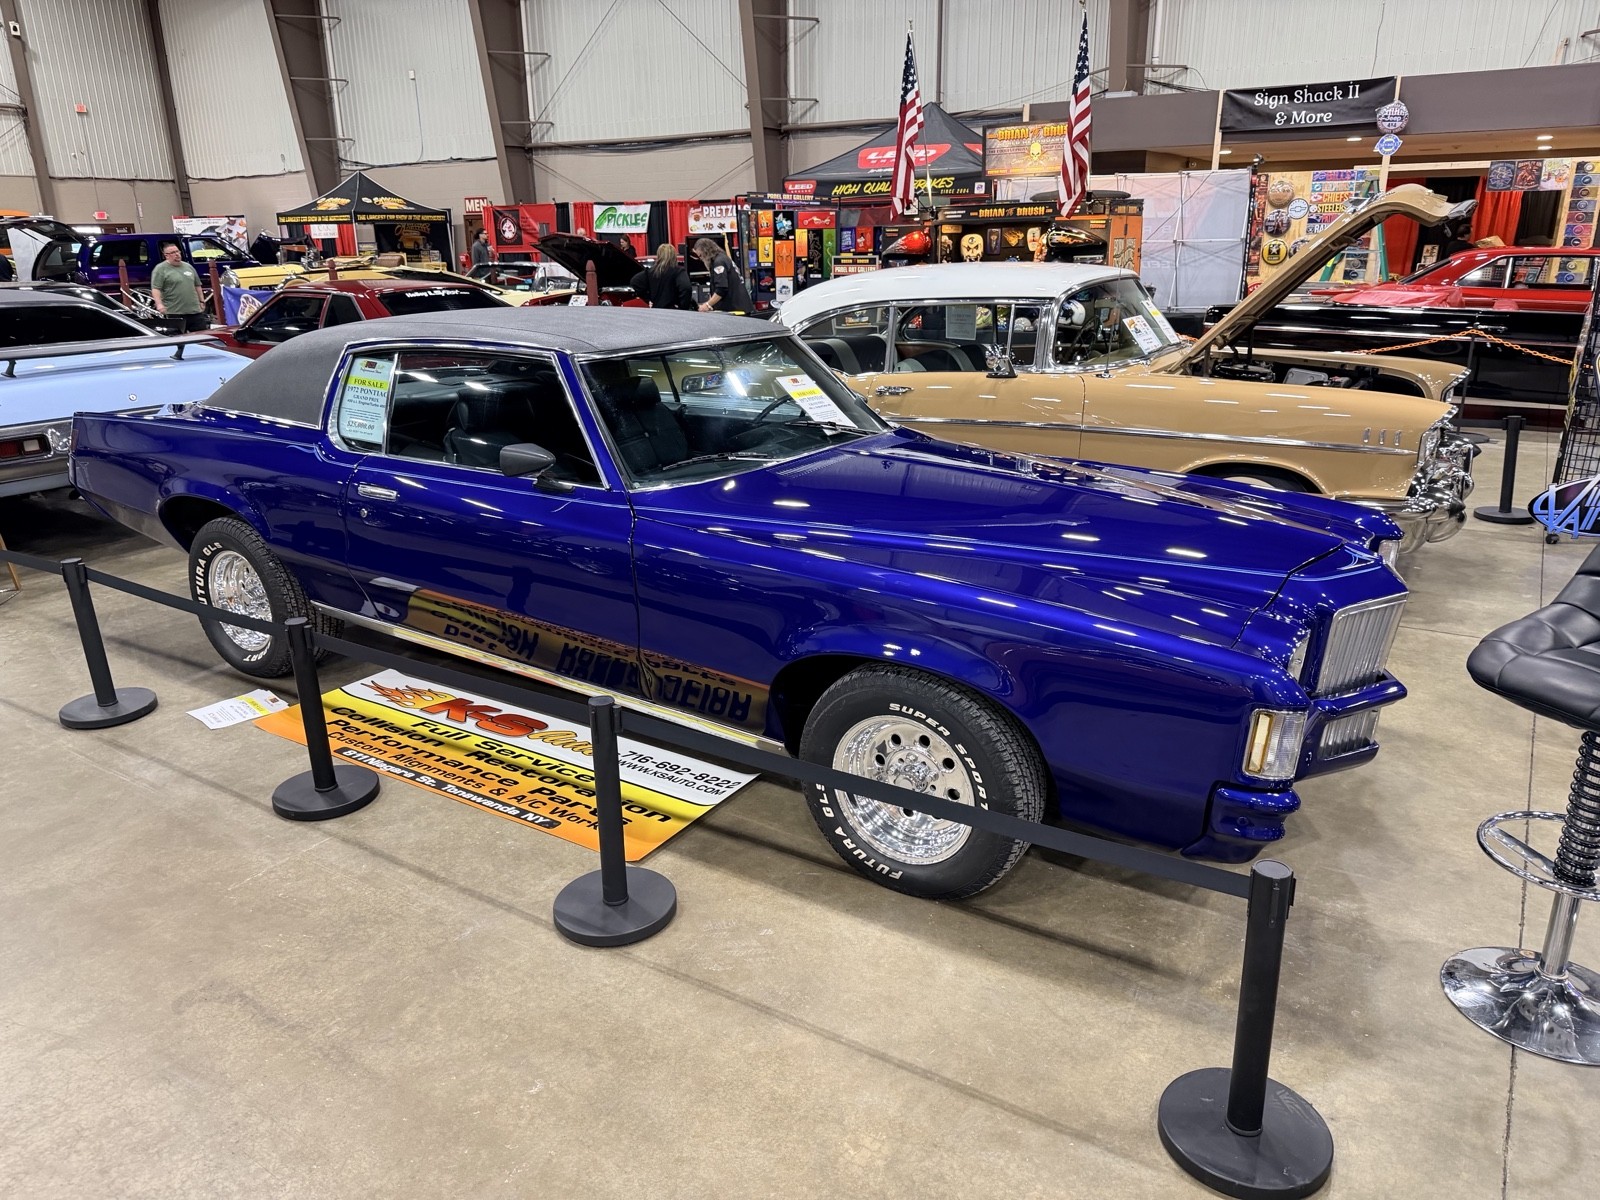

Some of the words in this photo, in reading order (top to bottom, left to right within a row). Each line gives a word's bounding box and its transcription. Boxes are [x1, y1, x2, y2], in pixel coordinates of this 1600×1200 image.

[1254, 92, 1289, 109] Sign
[1294, 86, 1343, 103] Shack
[1347, 84, 1360, 99] II
[1274, 112, 1287, 126] &
[1290, 111, 1332, 124] More
[998, 128, 1030, 140] BRIAN
[832, 183, 861, 195] HIGH
[863, 181, 893, 195] QUAL
[1323, 192, 1350, 202] CHIEFS
[465, 199, 487, 211] MEN
[979, 208, 1005, 218] BRIAN
[1016, 206, 1045, 216] BRUSH
[606, 212, 648, 229] PICKLES
[347, 385, 360, 393] 1972
[360, 387, 387, 398] PONTIAC
[354, 378, 366, 386] FOR
[368, 380, 384, 389] SALE
[195, 558, 208, 606] UTURA
[202, 541, 223, 556] GLS
[421, 697, 549, 737] K-S
[889, 703, 950, 737] SUPER
[326, 719, 519, 786] Performance
[411, 721, 472, 741] Full
[475, 740, 595, 783] Service
[328, 731, 387, 755] Custom
[388, 753, 485, 789] Alignments
[489, 787, 508, 797] &
[508, 794, 548, 809] A/C
[331, 707, 446, 747] Collision
[464, 750, 672, 823] Restoraion
[342, 749, 369, 761] 811
[366, 755, 415, 779] Niagara
[416, 773, 437, 787] St.
[442, 784, 521, 816] Tonawanda
[835, 826, 904, 880] FUTURA
